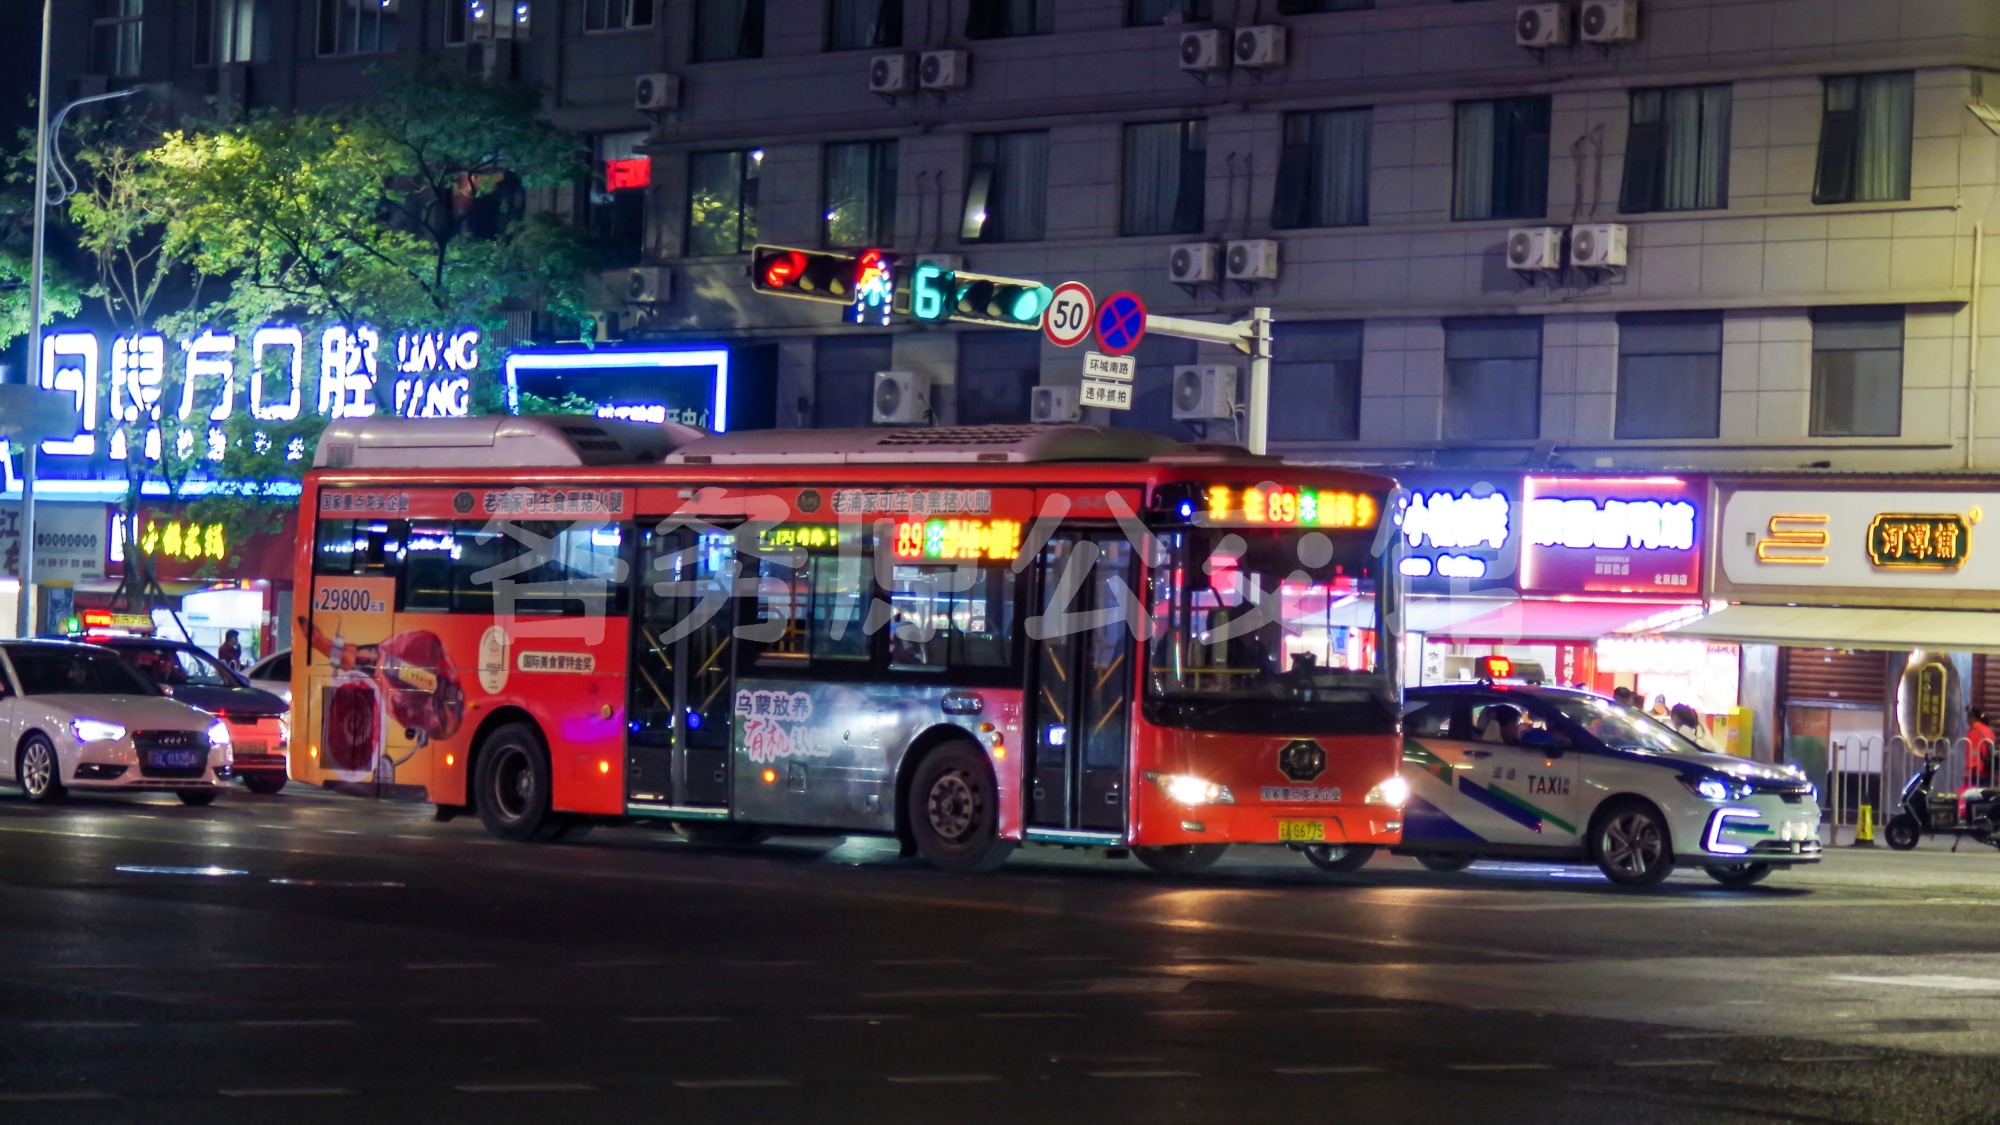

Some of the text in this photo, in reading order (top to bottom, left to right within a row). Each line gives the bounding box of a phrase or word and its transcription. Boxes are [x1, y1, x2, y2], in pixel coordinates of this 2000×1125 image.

[915, 266, 941, 319] 6
[1054, 300, 1083, 330] 50
[1090, 358, 1129, 375] 环城南路
[1085, 387, 1127, 404] 违停抓拍
[484, 491, 624, 513] 老浦家可生食黑猪火腿
[831, 489, 991, 514] 老浦家可生食黑猪火腿
[1268, 492, 1295, 522] 89
[898, 521, 923, 557] 89
[736, 694, 809, 717] 乌蒙放养
[1528, 775, 1562, 795] TAXI
